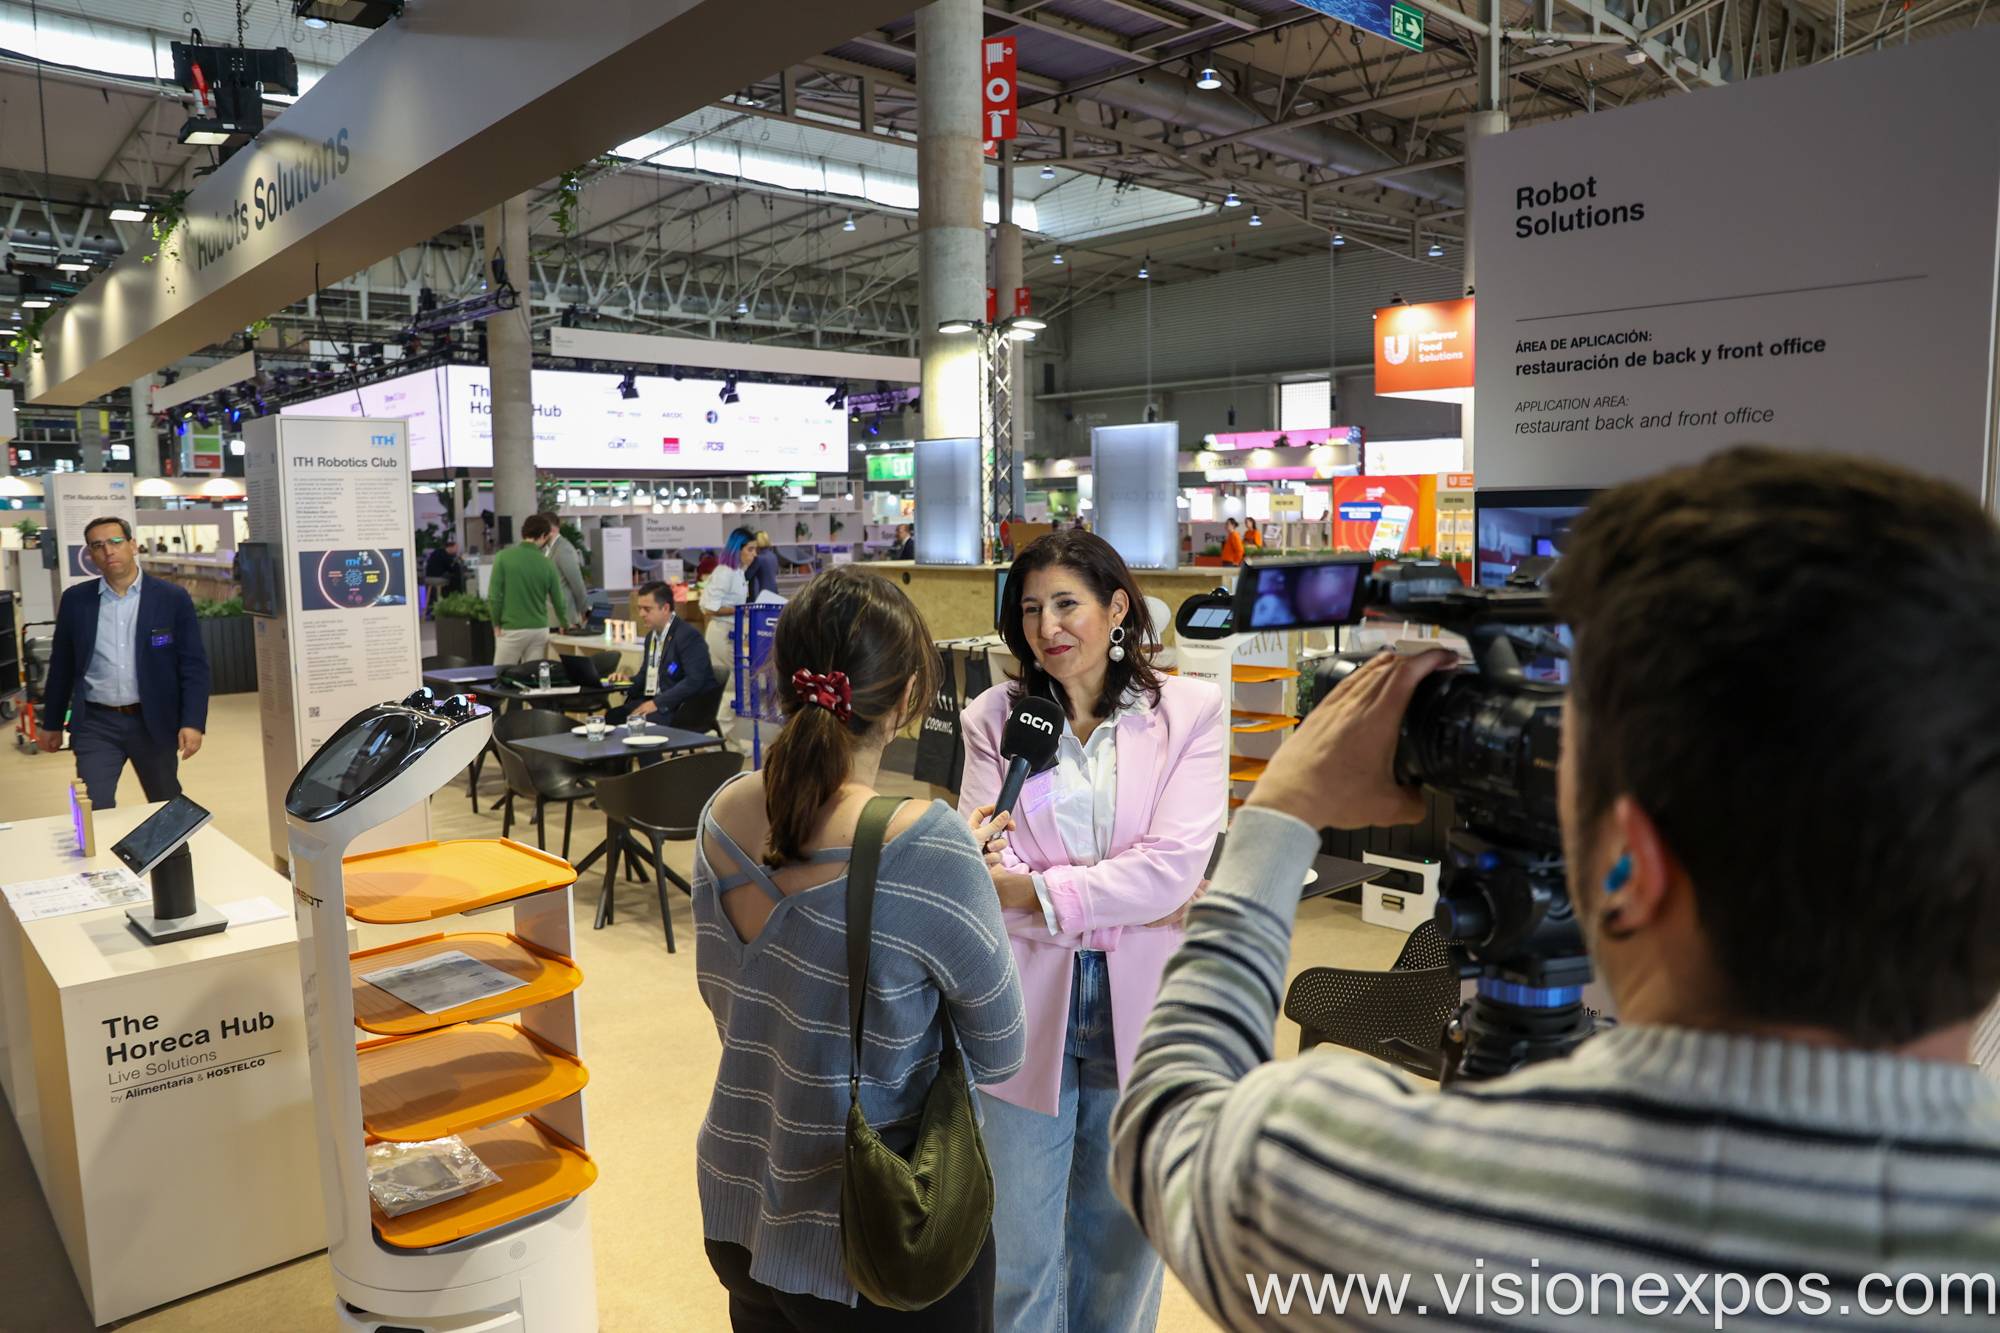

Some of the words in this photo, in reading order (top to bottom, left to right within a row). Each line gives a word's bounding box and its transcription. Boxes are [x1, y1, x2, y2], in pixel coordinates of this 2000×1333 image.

[254, 127, 350, 231] Solutions
[1516, 176, 1597, 210] Robot
[1516, 203, 1645, 239] Solutions
[1418, 341, 1443, 352] Food
[1515, 340, 1547, 353] ÁREA
[1550, 338, 1567, 350] DE
[1570, 329, 1652, 348] APLICACIÓN:
[1418, 351, 1464, 363] Solutions
[1515, 353, 1619, 376] restauración
[1625, 351, 1647, 367] de
[1653, 347, 1696, 365] back
[1701, 348, 1711, 365] y
[1717, 341, 1764, 360] front
[1769, 336, 1826, 356] office
[469, 384, 491, 397] Th
[532, 404, 562, 417] Hub
[1515, 398, 1590, 413] APPLICATION
[1593, 395, 1629, 408] AREA:
[1515, 417, 1590, 435] restaurant
[1595, 414, 1634, 431] back
[1639, 411, 1672, 429] and
[1678, 410, 1718, 427] front
[1724, 406, 1774, 425] office
[371, 435, 395, 446] ITH
[293, 456, 314, 467] ITH
[317, 456, 368, 468] Robotics
[371, 457, 398, 468] Club
[604, 618, 637, 644] ITH
[924, 716, 953, 735] COOKING
[1019, 712, 1054, 735] acn
[101, 1014, 159, 1039] The
[106, 1028, 211, 1066] Horeca
[220, 1011, 274, 1039] Hub
[108, 1068, 141, 1086] Live
[145, 1050, 217, 1077] Solutions
[110, 1094, 123, 1103] by
[125, 1076, 194, 1100] Alimentaria
[206, 1058, 265, 1080] HOSTELCO
